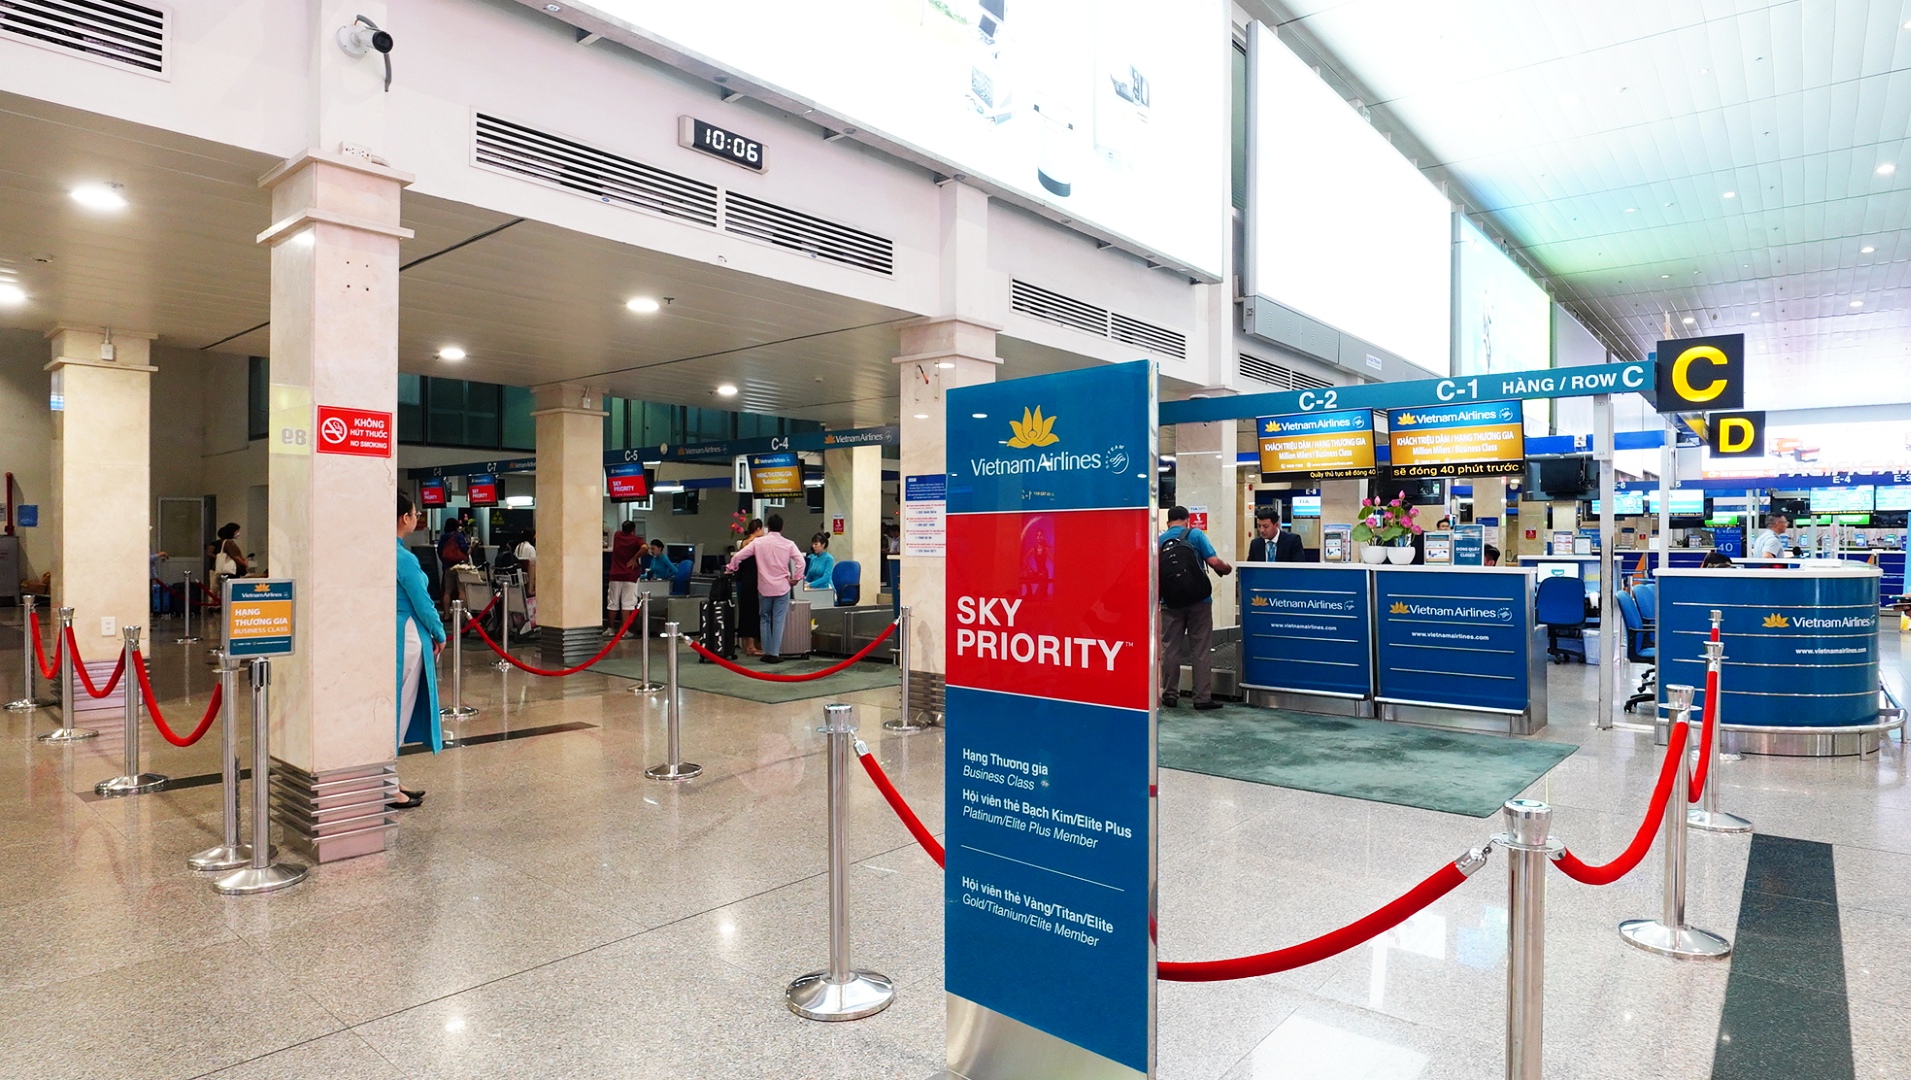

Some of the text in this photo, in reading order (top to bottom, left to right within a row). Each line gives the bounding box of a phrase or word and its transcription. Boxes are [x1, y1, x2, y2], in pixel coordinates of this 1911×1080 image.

[706, 129, 758, 162] 10:06
[1502, 375, 1554, 395] HÀNG
[1571, 373, 1617, 390] ROW
[1622, 365, 1644, 388] C
[1672, 346, 1728, 402] C
[1299, 390, 1337, 411] C-2
[1436, 378, 1478, 401] C-1
[350, 428, 388, 439] HÚT THUỐC
[354, 417, 384, 429] KHÔNG
[360, 441, 387, 449] SMOKING
[771, 437, 789, 451] C-4
[1719, 417, 1755, 453] D
[624, 450, 638, 461] C-5
[487, 462, 497, 472] C-7
[1409, 465, 1437, 476] đóng
[1440, 465, 1455, 474] 40
[1458, 463, 1484, 475] phút
[1487, 462, 1519, 472] trước
[1832, 475, 1851, 484] E-4
[1718, 542, 1733, 552] 40
[234, 617, 288, 626] THƯƠNG GIA
[235, 608, 260, 618] HẠNG
[956, 595, 1022, 627] SKY
[962, 748, 1048, 777] Hạng Thương gia
[963, 765, 1035, 791] Business Class
[962, 788, 1132, 839] Hội viên thẻ Bạch Kim/Elite Plus
[963, 805, 1098, 849] Platinum/Elite Plus Member
[962, 875, 1114, 934] Hội viên thẻ Vàng/Titan/Elite
[962, 893, 1099, 947] Gold/Titanium/Elite Member
